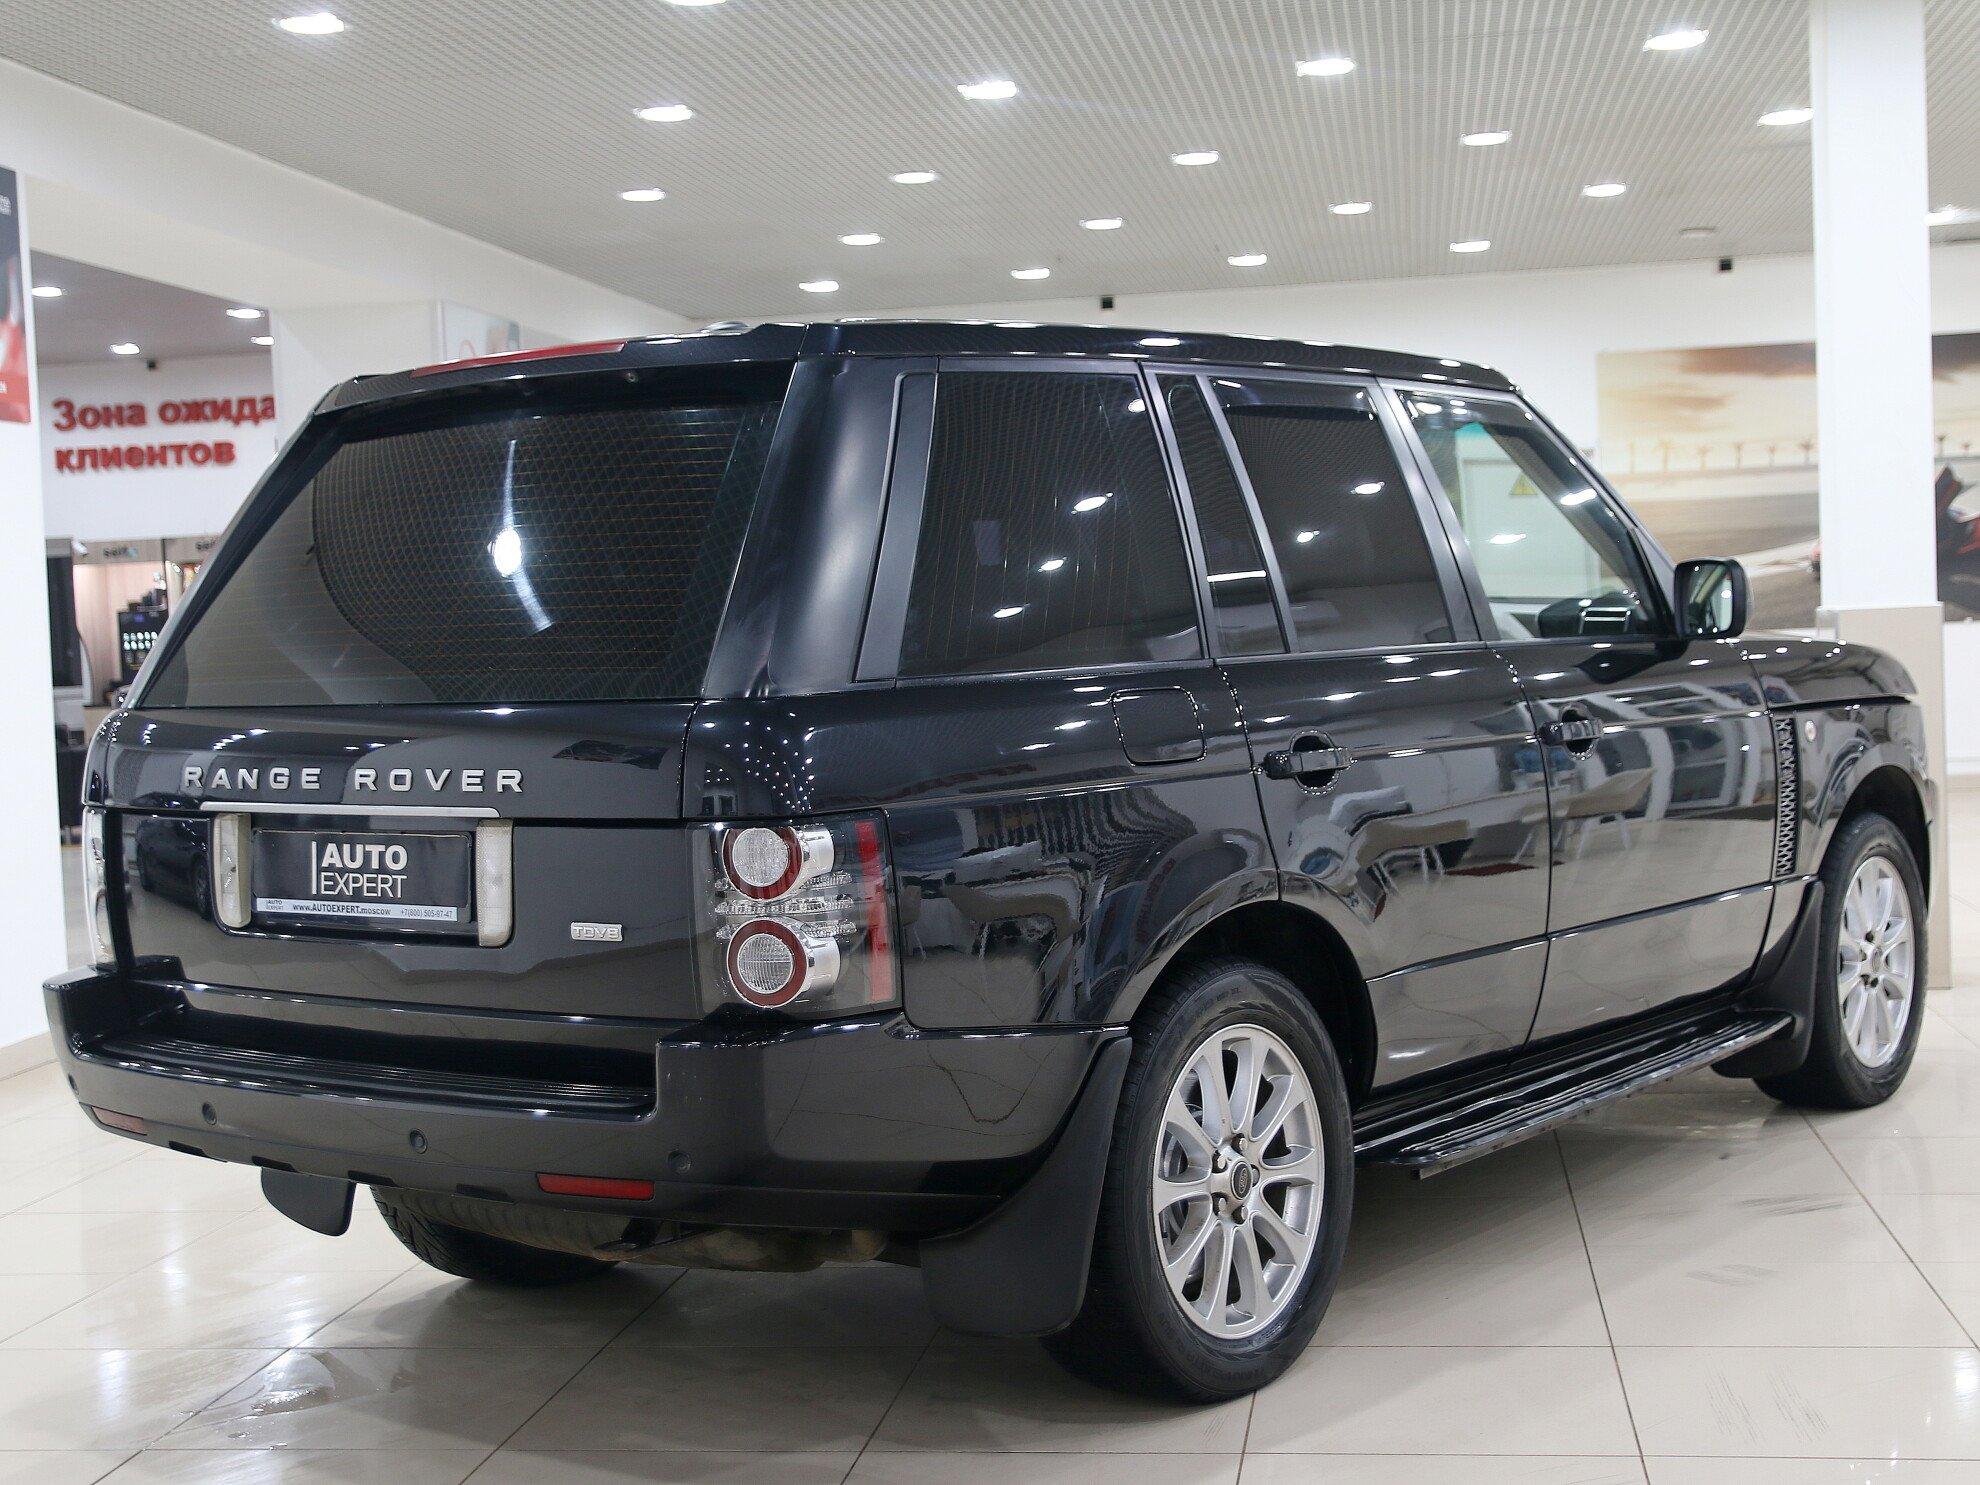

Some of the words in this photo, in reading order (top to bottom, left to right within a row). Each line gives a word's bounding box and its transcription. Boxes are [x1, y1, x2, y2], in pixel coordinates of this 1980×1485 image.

[53, 398, 146, 432] Зона
[55, 441, 235, 474] клиентов
[183, 766, 322, 791] RANGE
[354, 767, 523, 793] ROVER
[321, 842, 408, 871] AUTO
[320, 871, 408, 898] EXPERT
[292, 903, 392, 916] www.AUTOEXPERT.moscow
